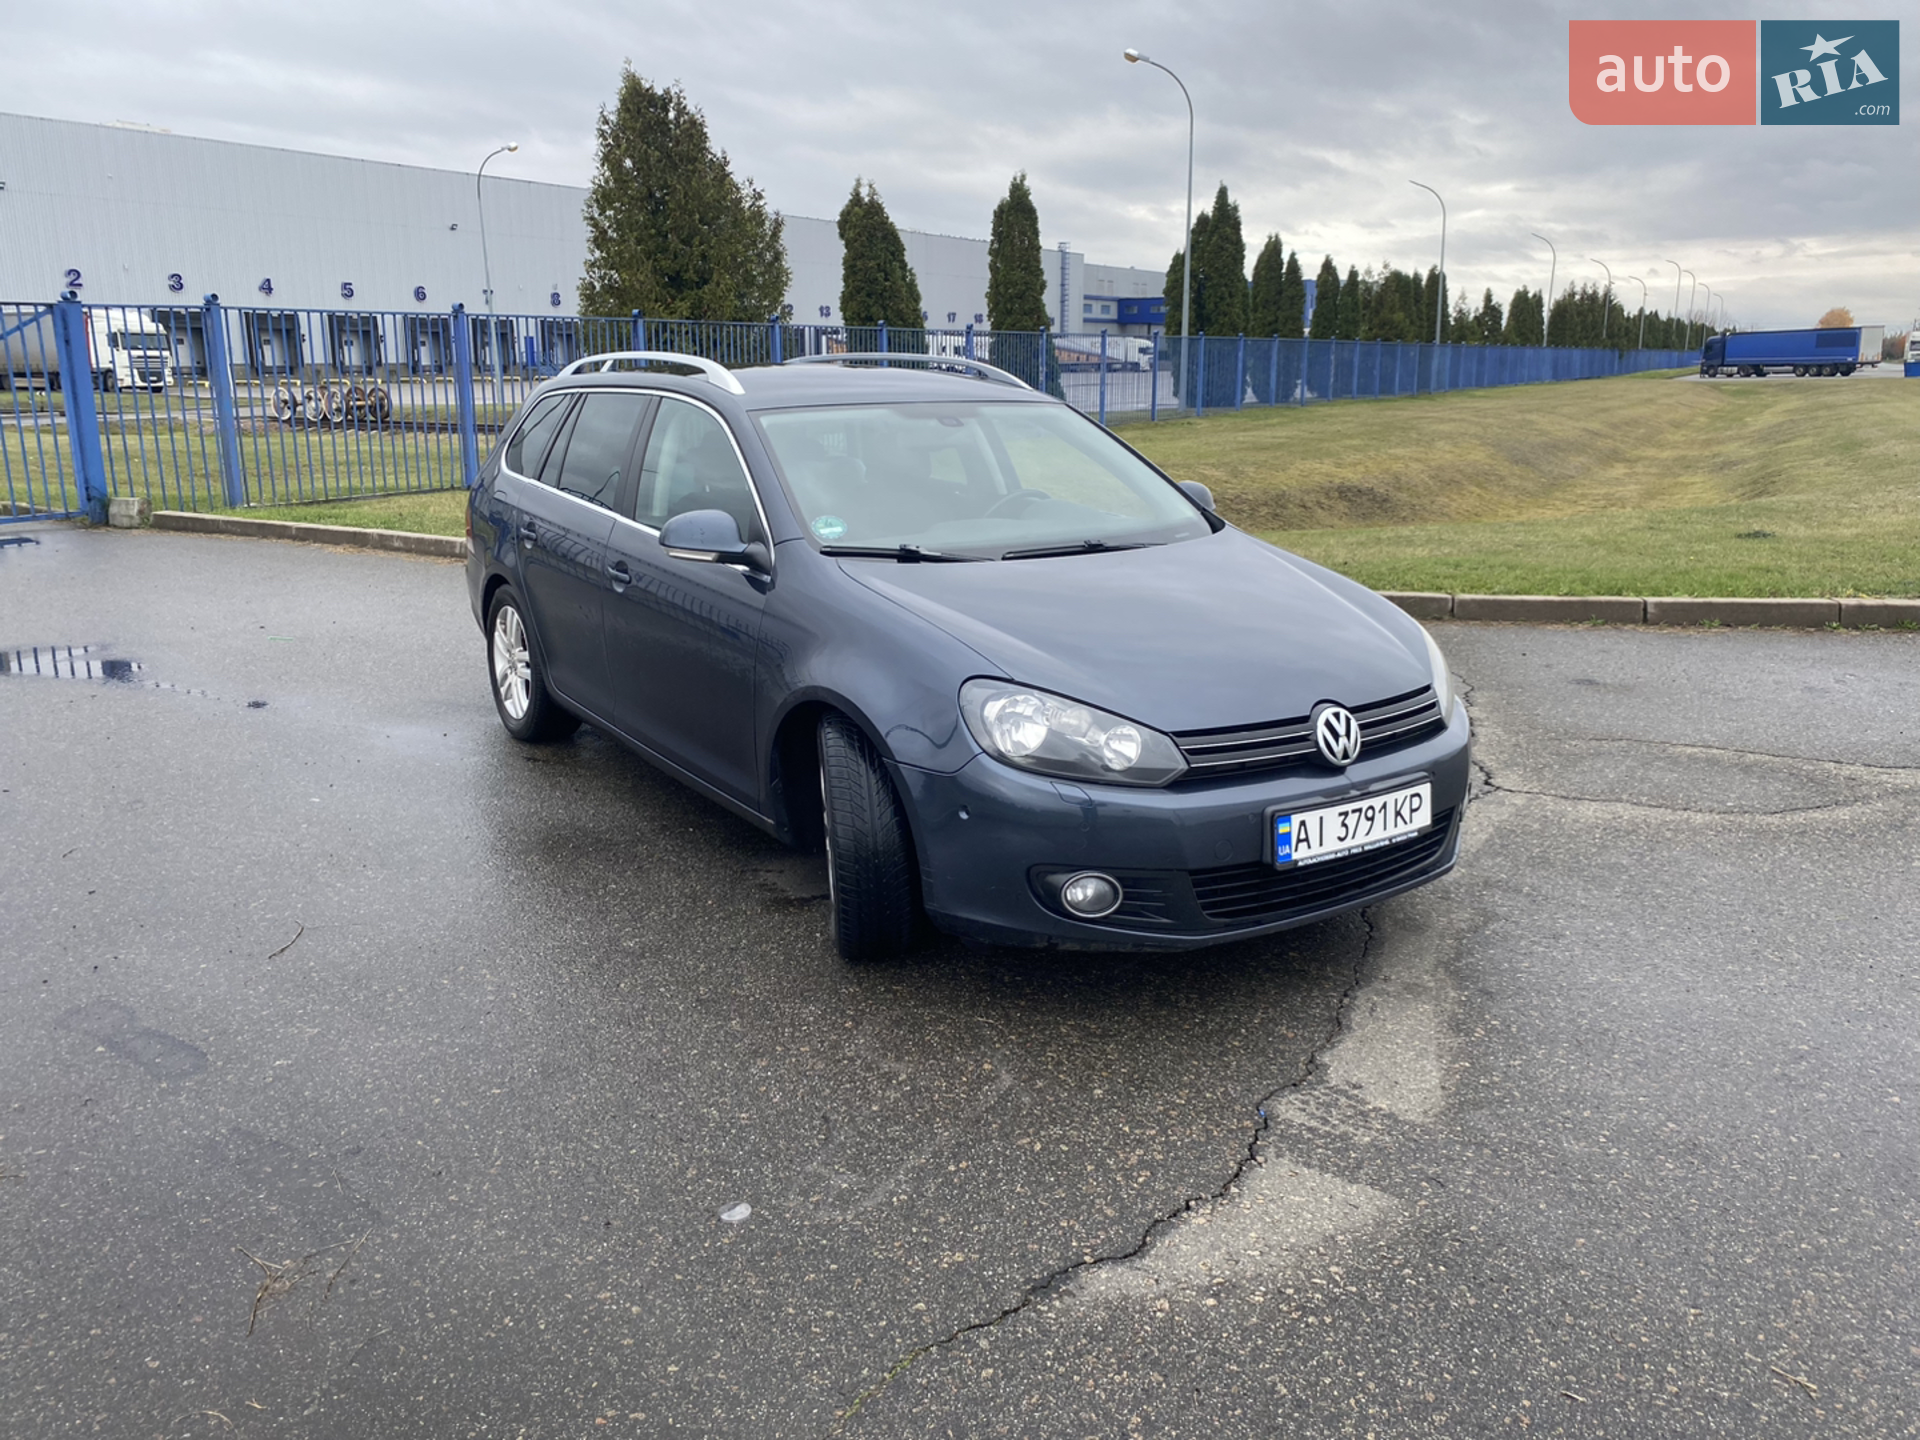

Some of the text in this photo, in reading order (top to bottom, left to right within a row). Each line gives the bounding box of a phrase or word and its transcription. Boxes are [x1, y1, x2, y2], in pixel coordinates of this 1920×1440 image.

[65, 268, 83, 288] 2
[168, 273, 184, 292] 3
[259, 278, 274, 296] 4
[341, 282, 354, 300] 5
[414, 286, 427, 302] 6
[551, 292, 561, 307] 8
[819, 305, 831, 318] 13
[947, 311, 957, 324] 17
[1317, 707, 1361, 766] VW
[1294, 815, 1324, 853] AI
[1337, 801, 1387, 842] 3791
[1394, 792, 1423, 829] KP
[1278, 844, 1291, 856] UA
